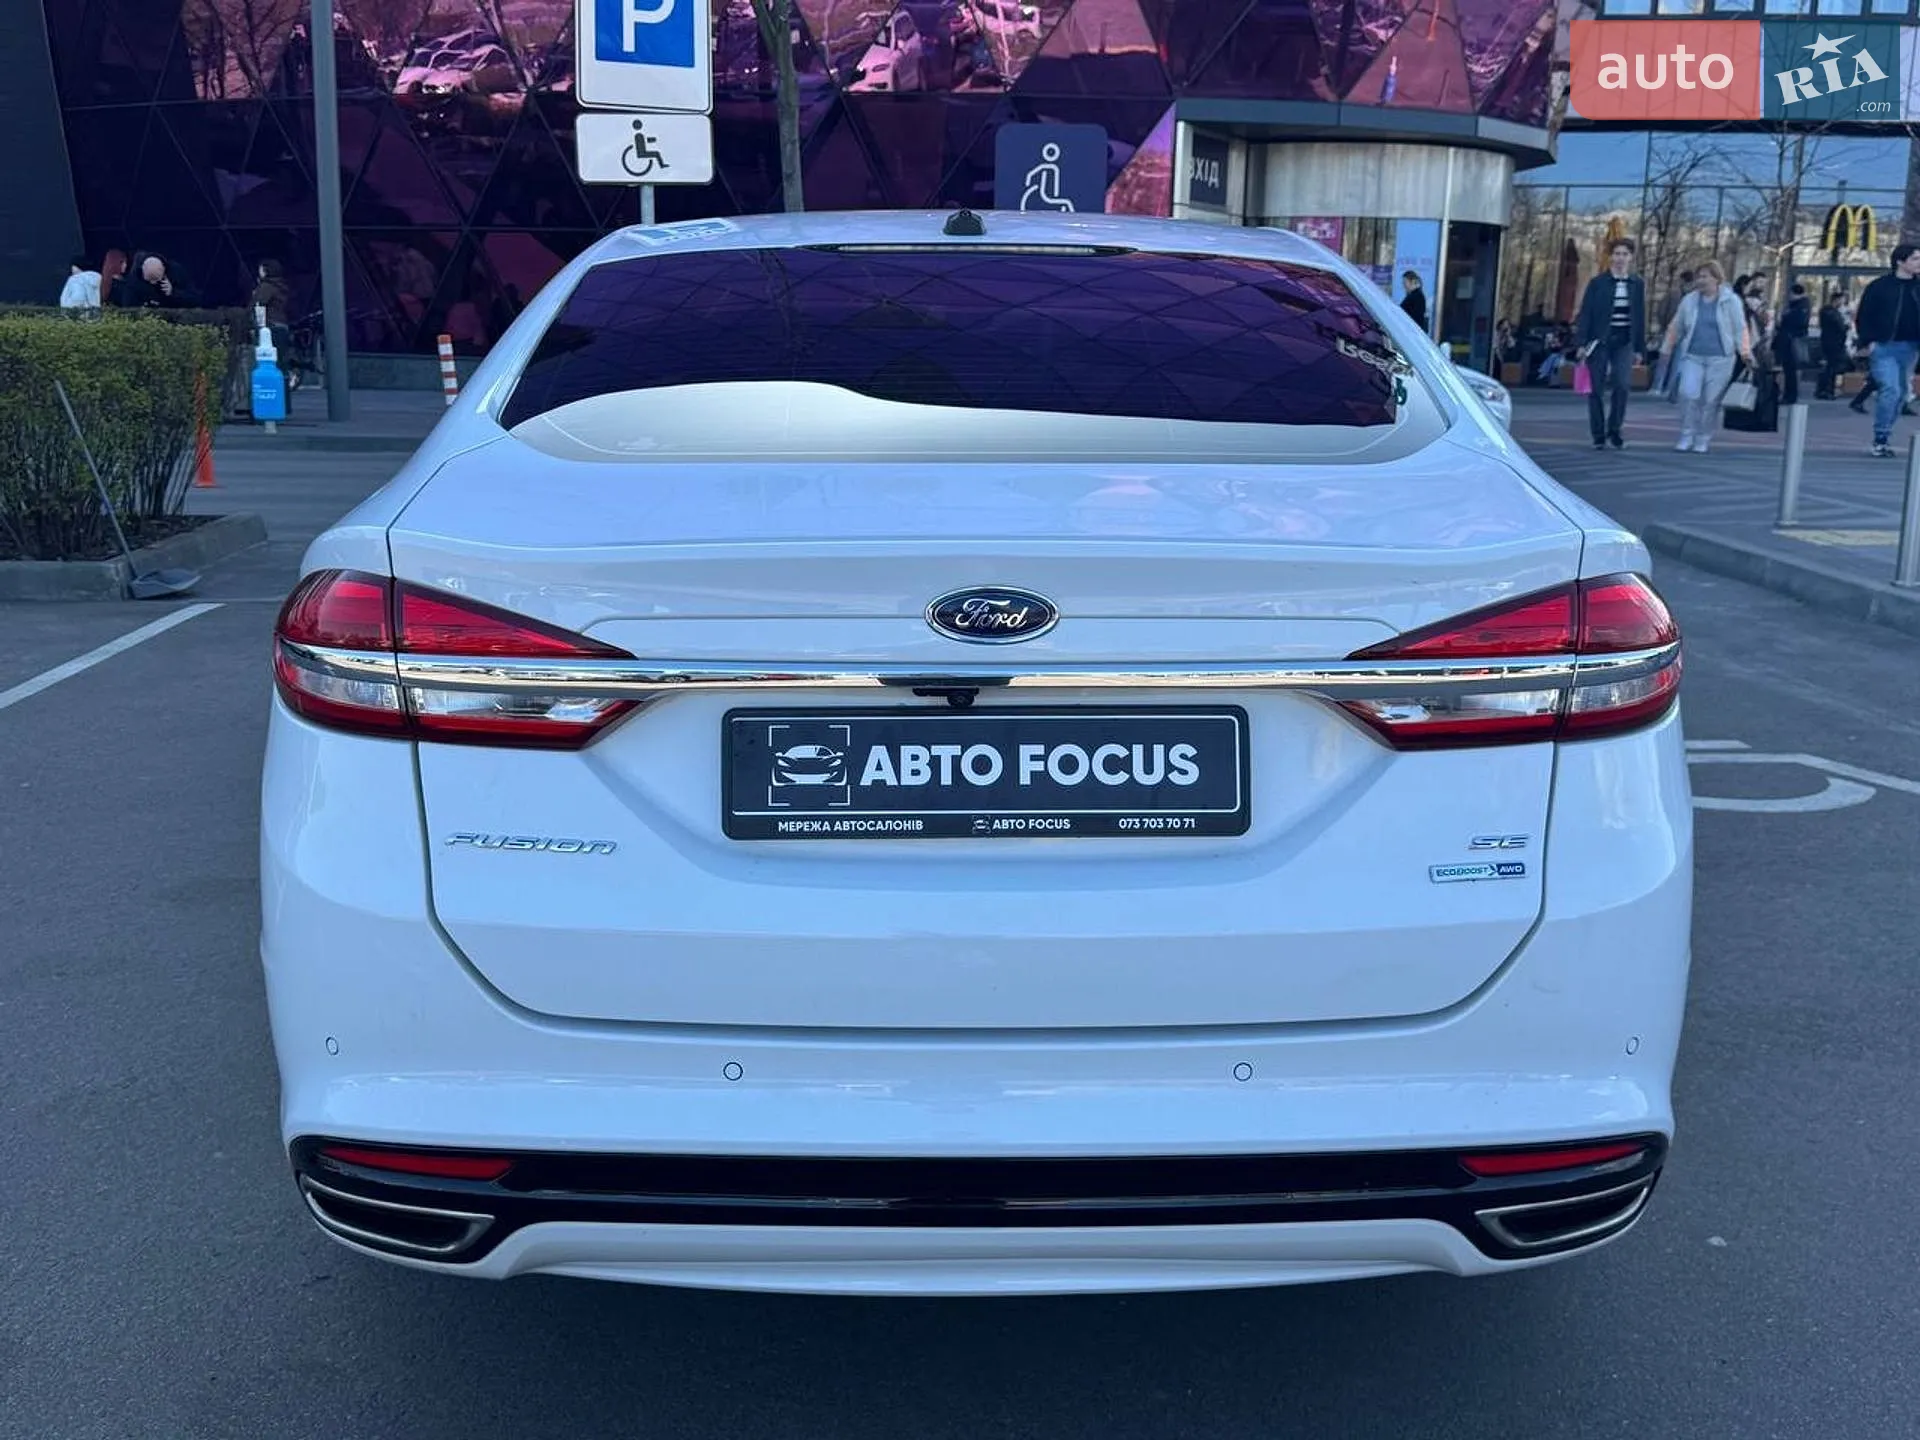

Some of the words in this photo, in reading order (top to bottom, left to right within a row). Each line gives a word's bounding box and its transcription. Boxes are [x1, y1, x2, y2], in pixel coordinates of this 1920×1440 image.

[622, 0, 675, 52] P
[955, 598, 1028, 628] Ford
[859, 744, 1003, 786] АВТО
[1018, 744, 1200, 786] FOCUS
[778, 820, 831, 832] МЕРЕЖА
[834, 820, 924, 832] АВТОСАЛОНІВ
[993, 818, 1025, 830] АВТО
[1028, 818, 1071, 830] FOCUS
[1118, 817, 1140, 829] 073
[1143, 817, 1163, 829] 703
[1166, 817, 1181, 829] 70
[1183, 817, 1196, 829] 71
[444, 832, 618, 855] FUSION
[1468, 834, 1528, 850] SE
[1435, 866, 1488, 877] ECOBOOST
[1499, 865, 1523, 874] AWD
